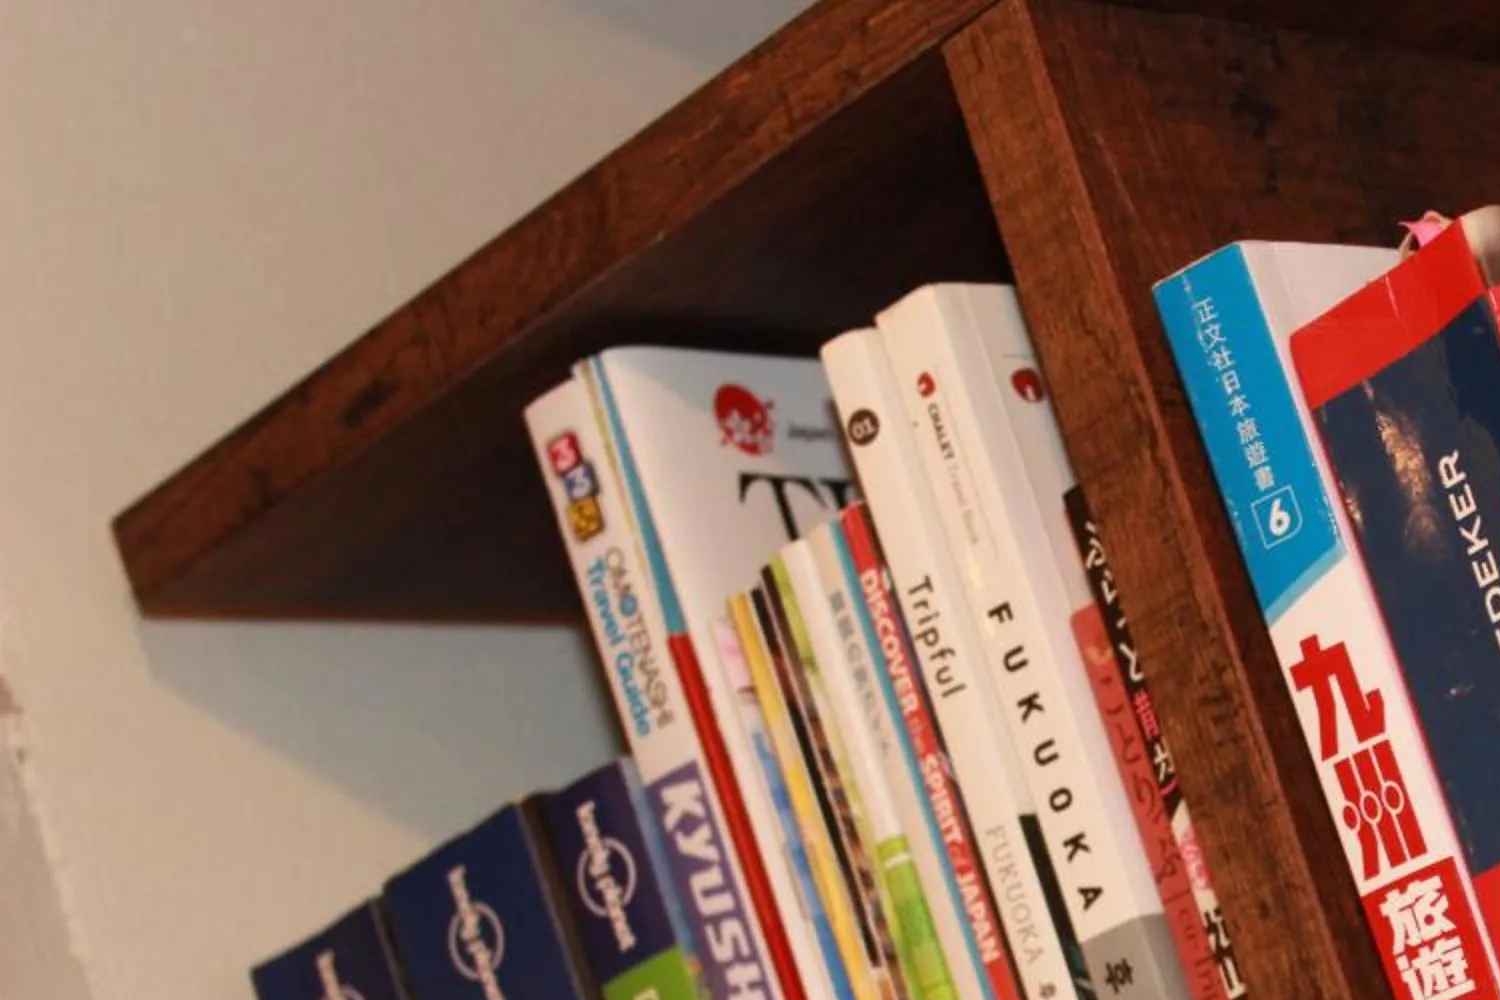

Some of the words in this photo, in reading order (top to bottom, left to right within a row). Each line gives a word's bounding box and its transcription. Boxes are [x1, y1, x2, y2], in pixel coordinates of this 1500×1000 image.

[1268, 498, 1291, 536] 6
[908, 575, 967, 697] Tripful
[861, 569, 919, 714] DISCOVER
[923, 752, 964, 845] SPIRIT
[957, 870, 1001, 963] JAPAN
[987, 600, 1104, 911] FUKUOKA
[1289, 634, 1428, 881] 九州
[986, 825, 1044, 966] FUKUOKA
